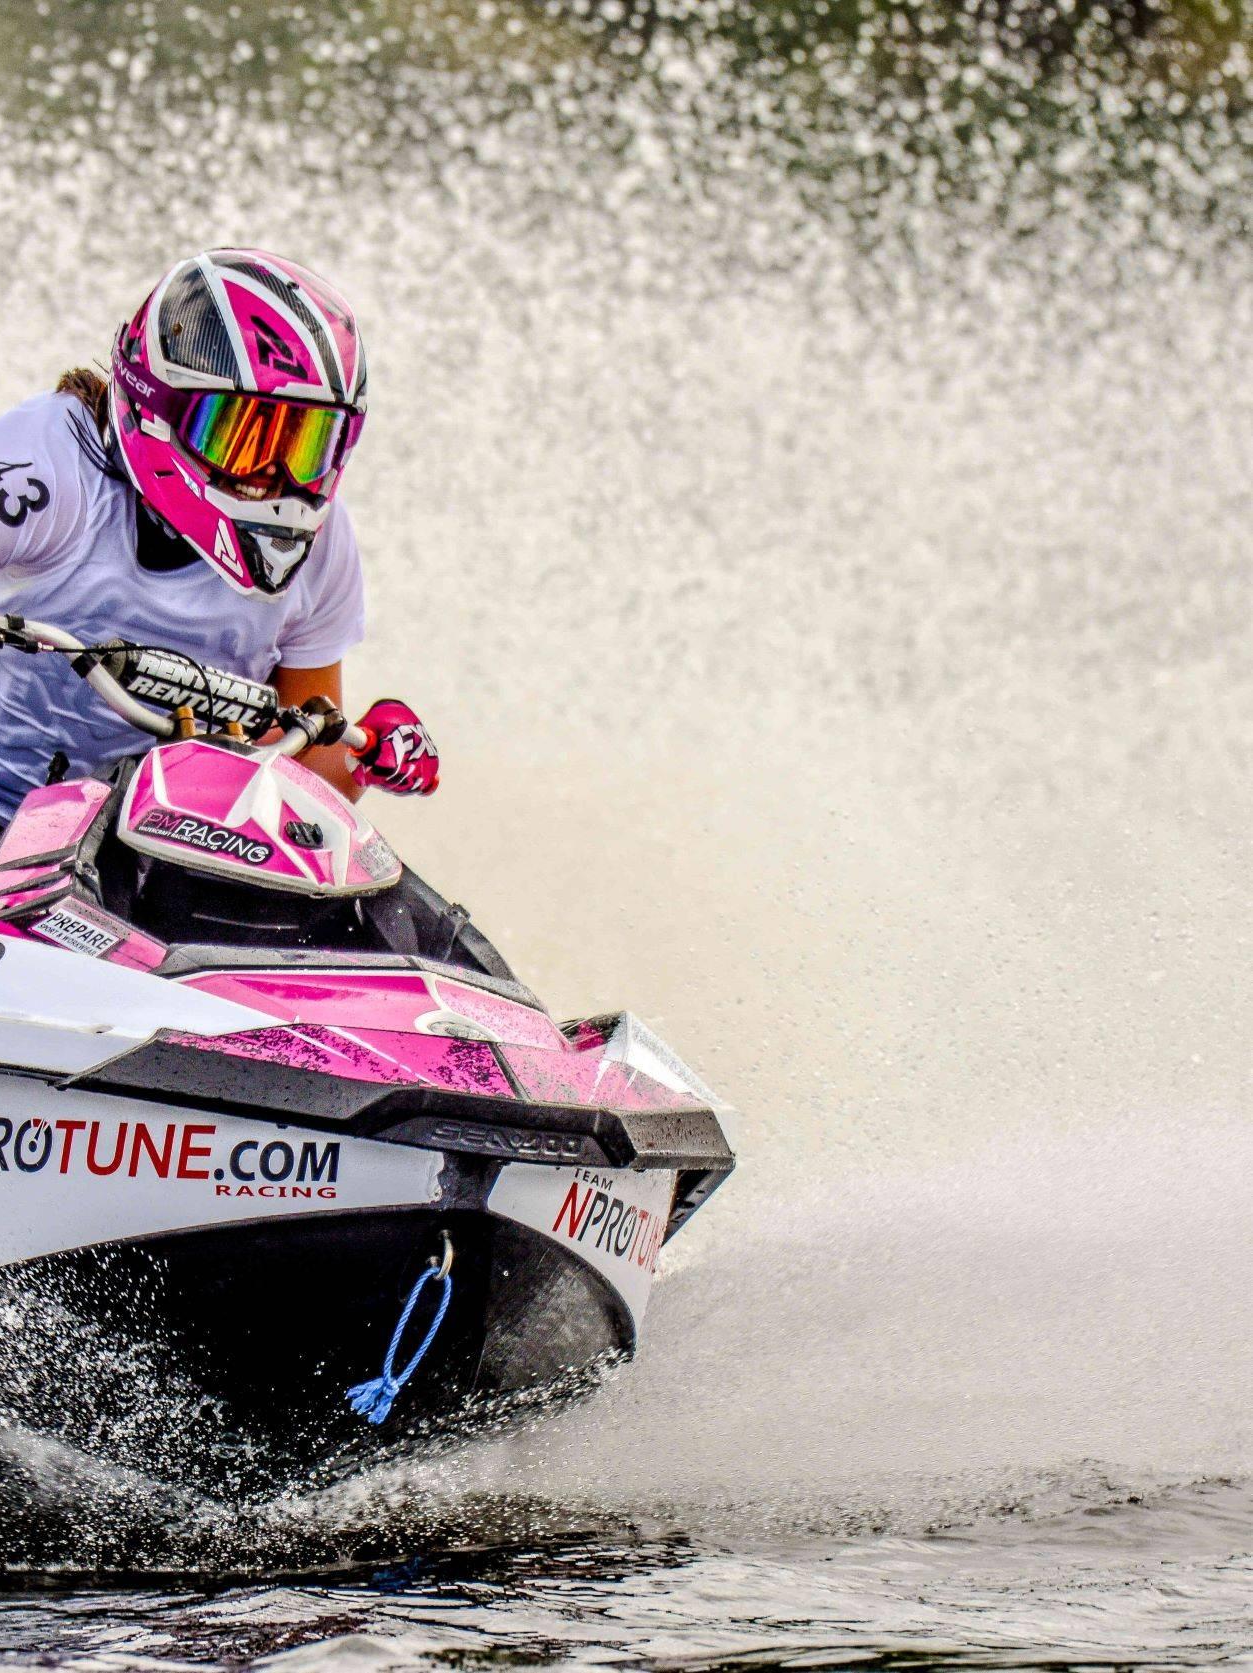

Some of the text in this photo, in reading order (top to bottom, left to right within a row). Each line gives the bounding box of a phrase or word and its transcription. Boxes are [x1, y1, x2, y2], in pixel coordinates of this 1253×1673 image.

[46, 912, 113, 950] PREPARE
[574, 1167, 614, 1191] TEAM
[215, 1184, 338, 1199] RACING
